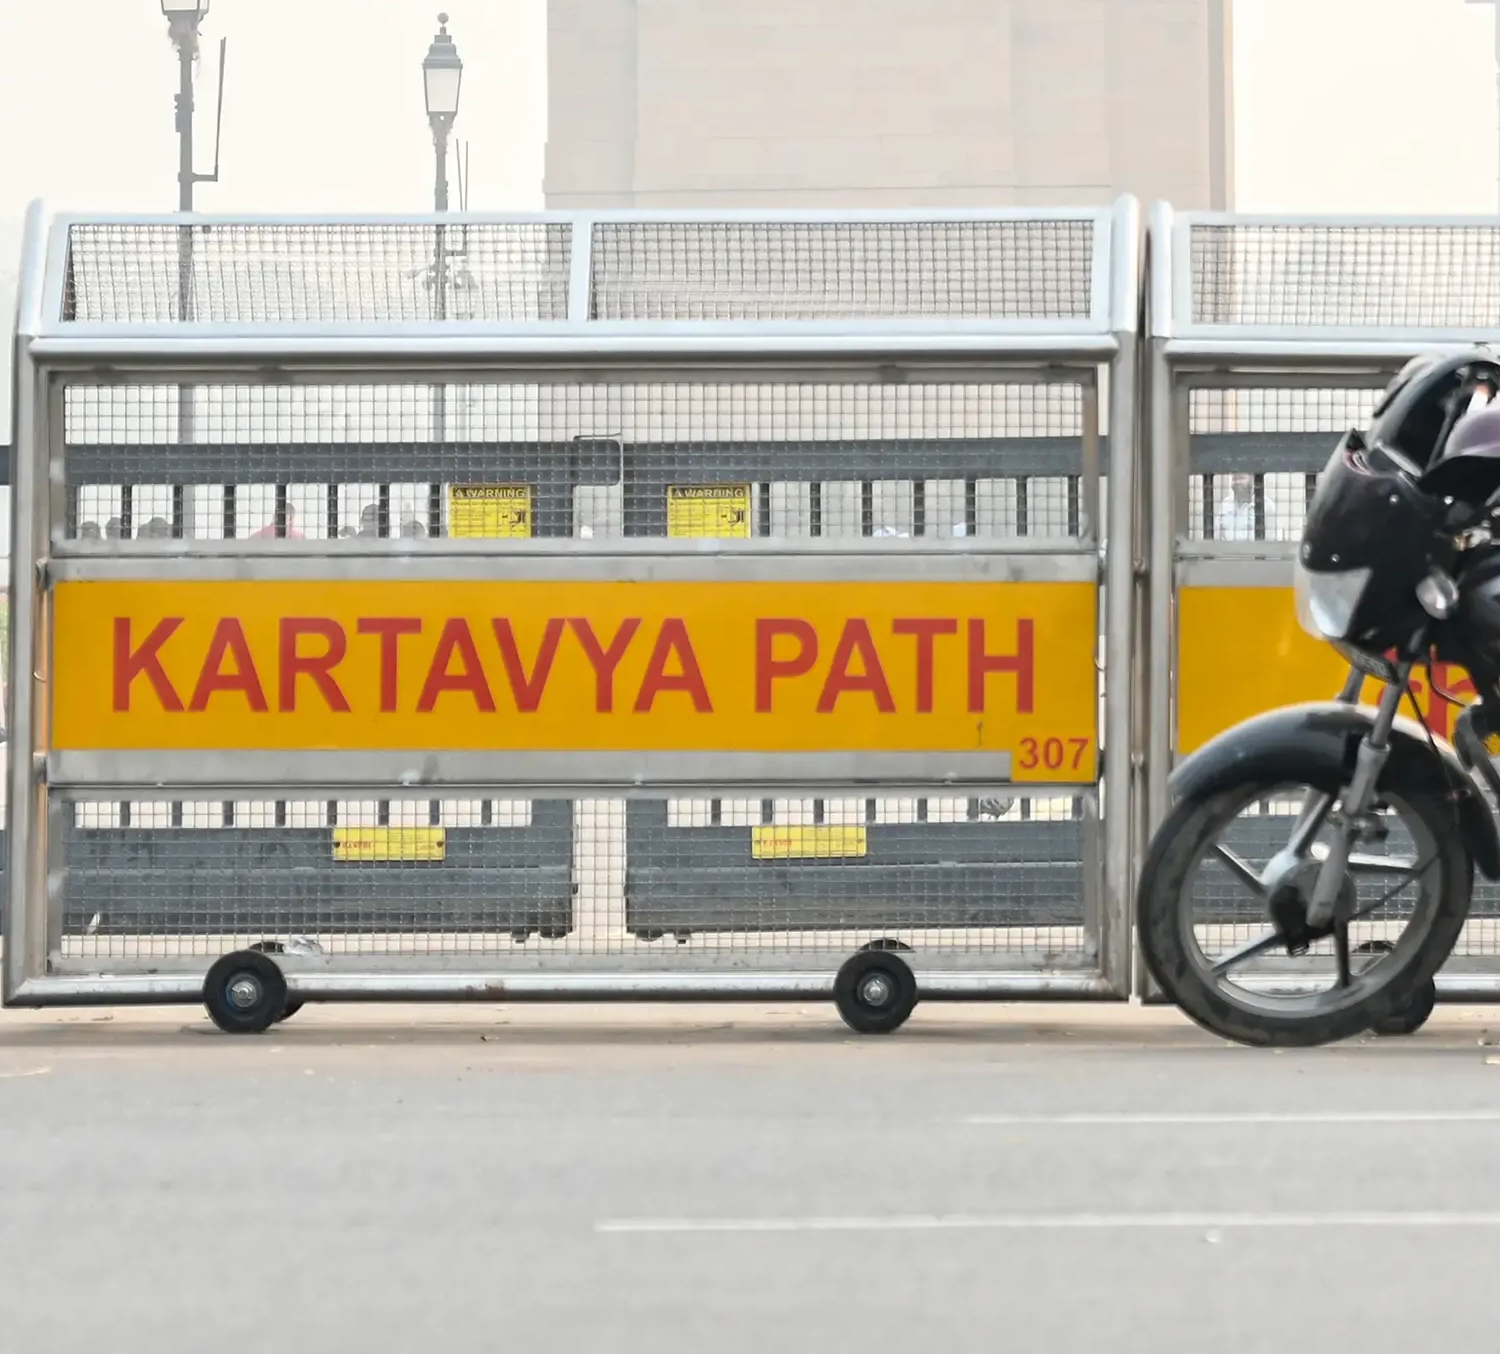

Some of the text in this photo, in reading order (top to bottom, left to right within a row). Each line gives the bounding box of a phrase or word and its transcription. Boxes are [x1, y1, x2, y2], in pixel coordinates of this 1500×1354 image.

[466, 488, 525, 498] WARNING
[684, 488, 744, 498] WARNING
[112, 616, 1035, 714] KARTAVYA PATH
[1018, 736, 1089, 770] 307
